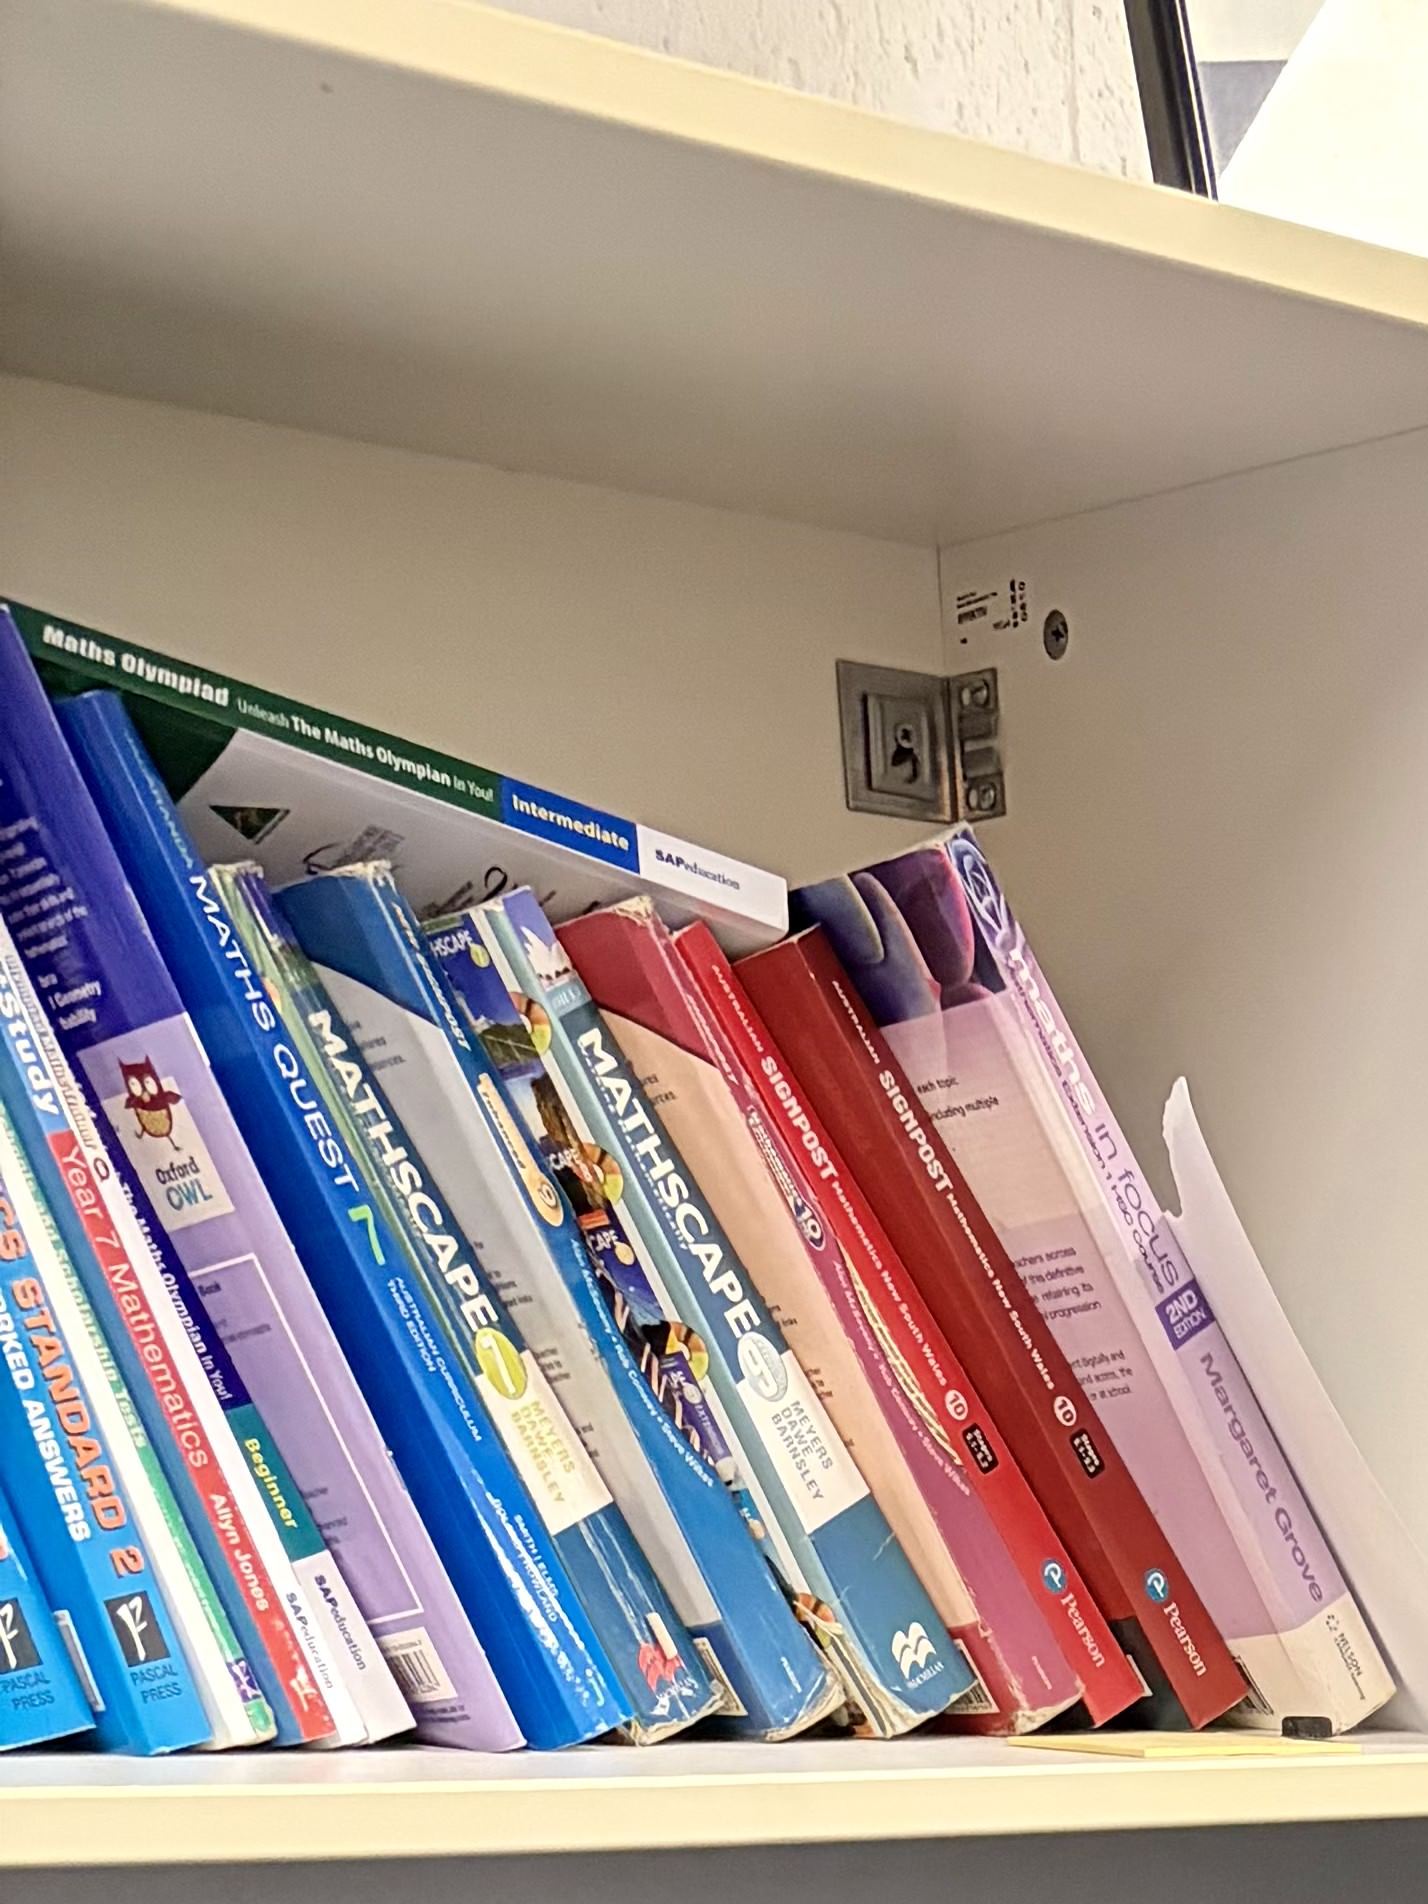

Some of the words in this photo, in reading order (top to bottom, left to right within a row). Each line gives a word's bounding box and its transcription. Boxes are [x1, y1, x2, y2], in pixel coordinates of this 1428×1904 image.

[43, 625, 115, 667] Maths
[121, 652, 229, 707] Olympiad
[291, 715, 321, 741] The
[324, 726, 375, 760] Maths
[376, 745, 451, 788] Olympian
[512, 793, 630, 852] Intermediate
[655, 848, 741, 891] SAPeducation
[189, 876, 276, 1031] MATHS
[273, 1044, 359, 1191] QUEST
[347, 1205, 385, 1266] 7
[1009, 949, 1096, 1117] maths
[156, 1157, 199, 1184] Oxford
[167, 1180, 213, 1211] OWL
[308, 1009, 499, 1332] MATHSCAPE
[577, 1027, 761, 1339] MATHSCAPE
[712, 964, 765, 1053] AUSTRALIAN
[761, 1055, 839, 1180] SIGNPOST
[831, 1180, 884, 1271] Mathematics
[899, 1302, 925, 1344] South
[922, 1343, 948, 1387] Wales
[832, 979, 880, 1065] AUSTRALIAN
[878, 1069, 953, 1192] SIGNPOST
[947, 1193, 995, 1278] Mathematics
[1009, 1310, 1033, 1349] South
[1031, 1348, 1055, 1390] Wales
[62, 1145, 104, 1221] Year
[108, 1262, 208, 1468] Mathematics
[1165, 1289, 1198, 1325] 2ND
[12, 1277, 128, 1531] STANDARD
[110, 1545, 144, 1579] 2
[437, 1356, 482, 1442] CURRICULUM
[781, 1407, 813, 1458] DAWE
[791, 1400, 833, 1471] MEYERS
[23, 1399, 91, 1543] ANSWERS
[244, 1437, 298, 1529] Beginner
[772, 1412, 824, 1500] BARNSLEY
[1200, 1352, 1278, 1505] Margaret
[1274, 1507, 1324, 1603] Grove
[234, 1550, 268, 1612] Jones
[314, 1574, 367, 1672] SAPeducation
[130, 1663, 179, 1686] PASCAL
[1060, 1593, 1106, 1668] Pearson
[1164, 1601, 1207, 1678] Pearson
[1336, 1632, 1363, 1678] NELSON
[141, 1682, 182, 1704] PRESS
